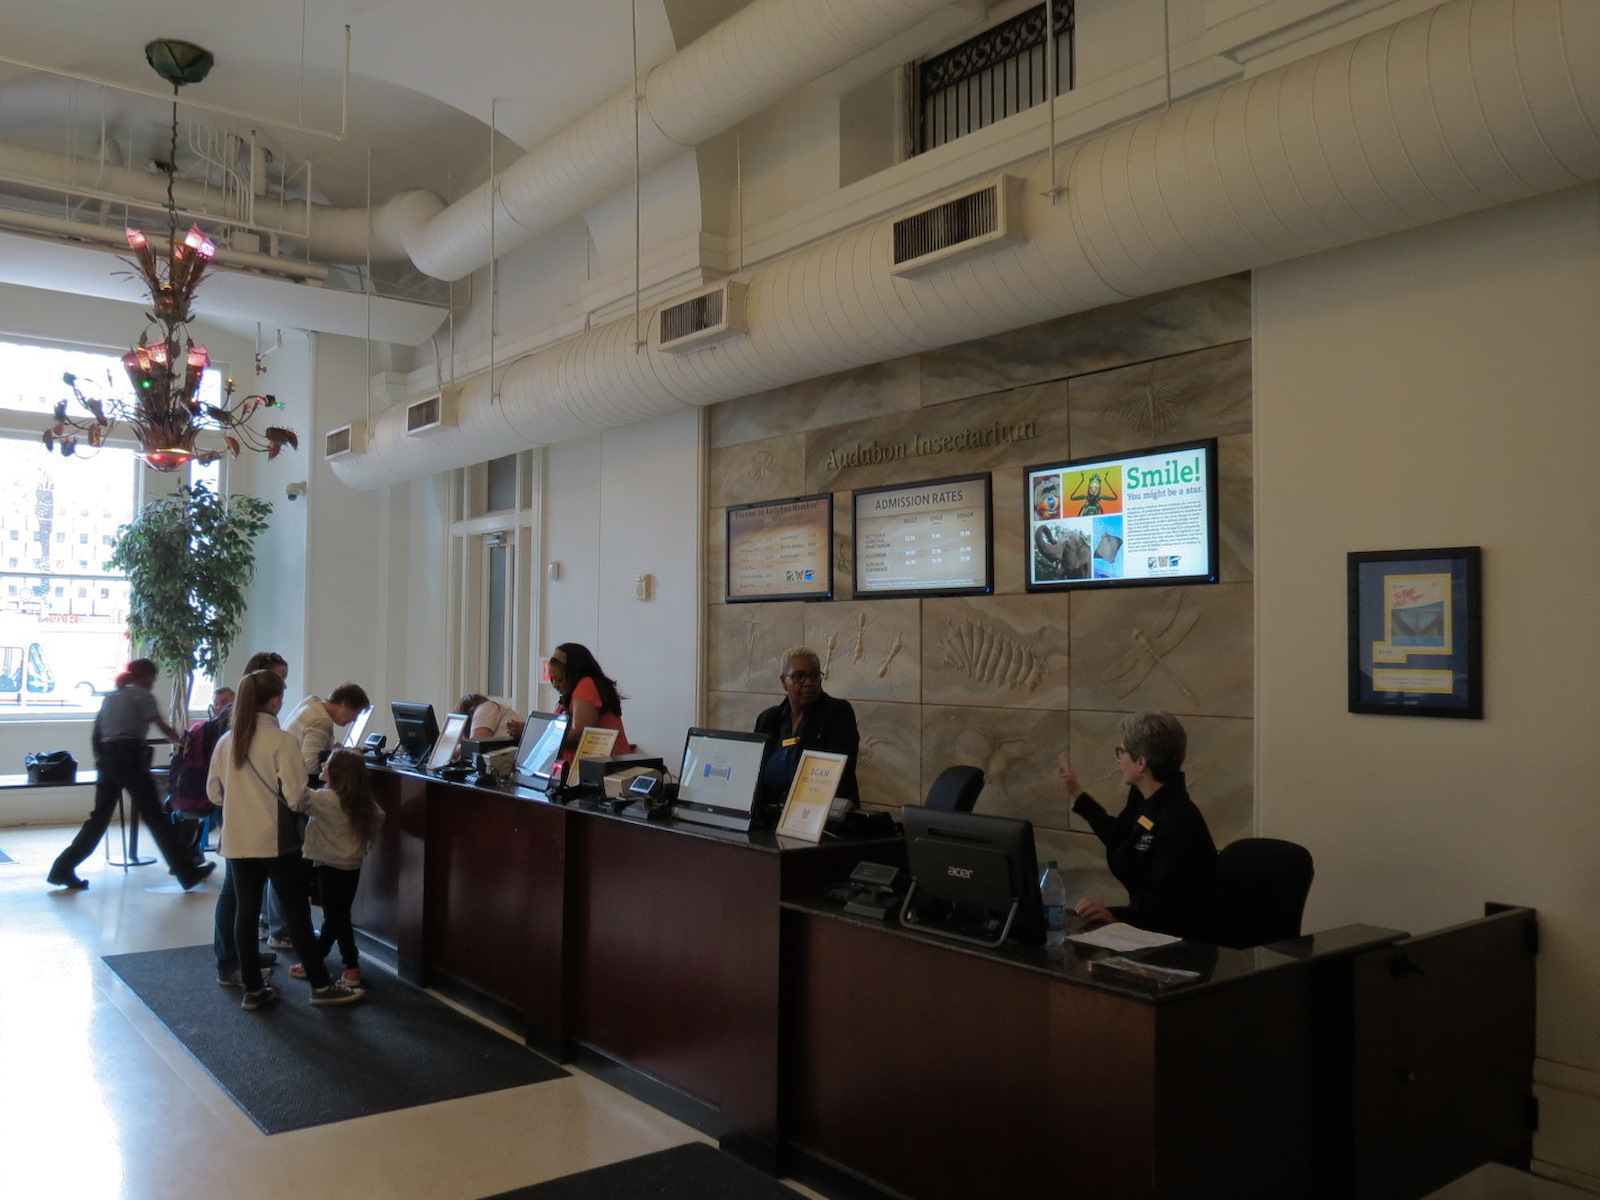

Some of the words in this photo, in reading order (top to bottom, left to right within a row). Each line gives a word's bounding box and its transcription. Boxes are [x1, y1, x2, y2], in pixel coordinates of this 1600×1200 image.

[825, 441, 907, 471] Audubon
[914, 421, 1038, 457] Insectarium
[1126, 457, 1201, 489] Smile!
[875, 494, 930, 511] ADMISSION
[932, 490, 963, 504] RATES
[1127, 492, 1141, 501] You
[1143, 489, 1166, 500] might
[1167, 488, 1177, 496] be
[810, 767, 830, 777] SCAN
[947, 866, 974, 879] acer
